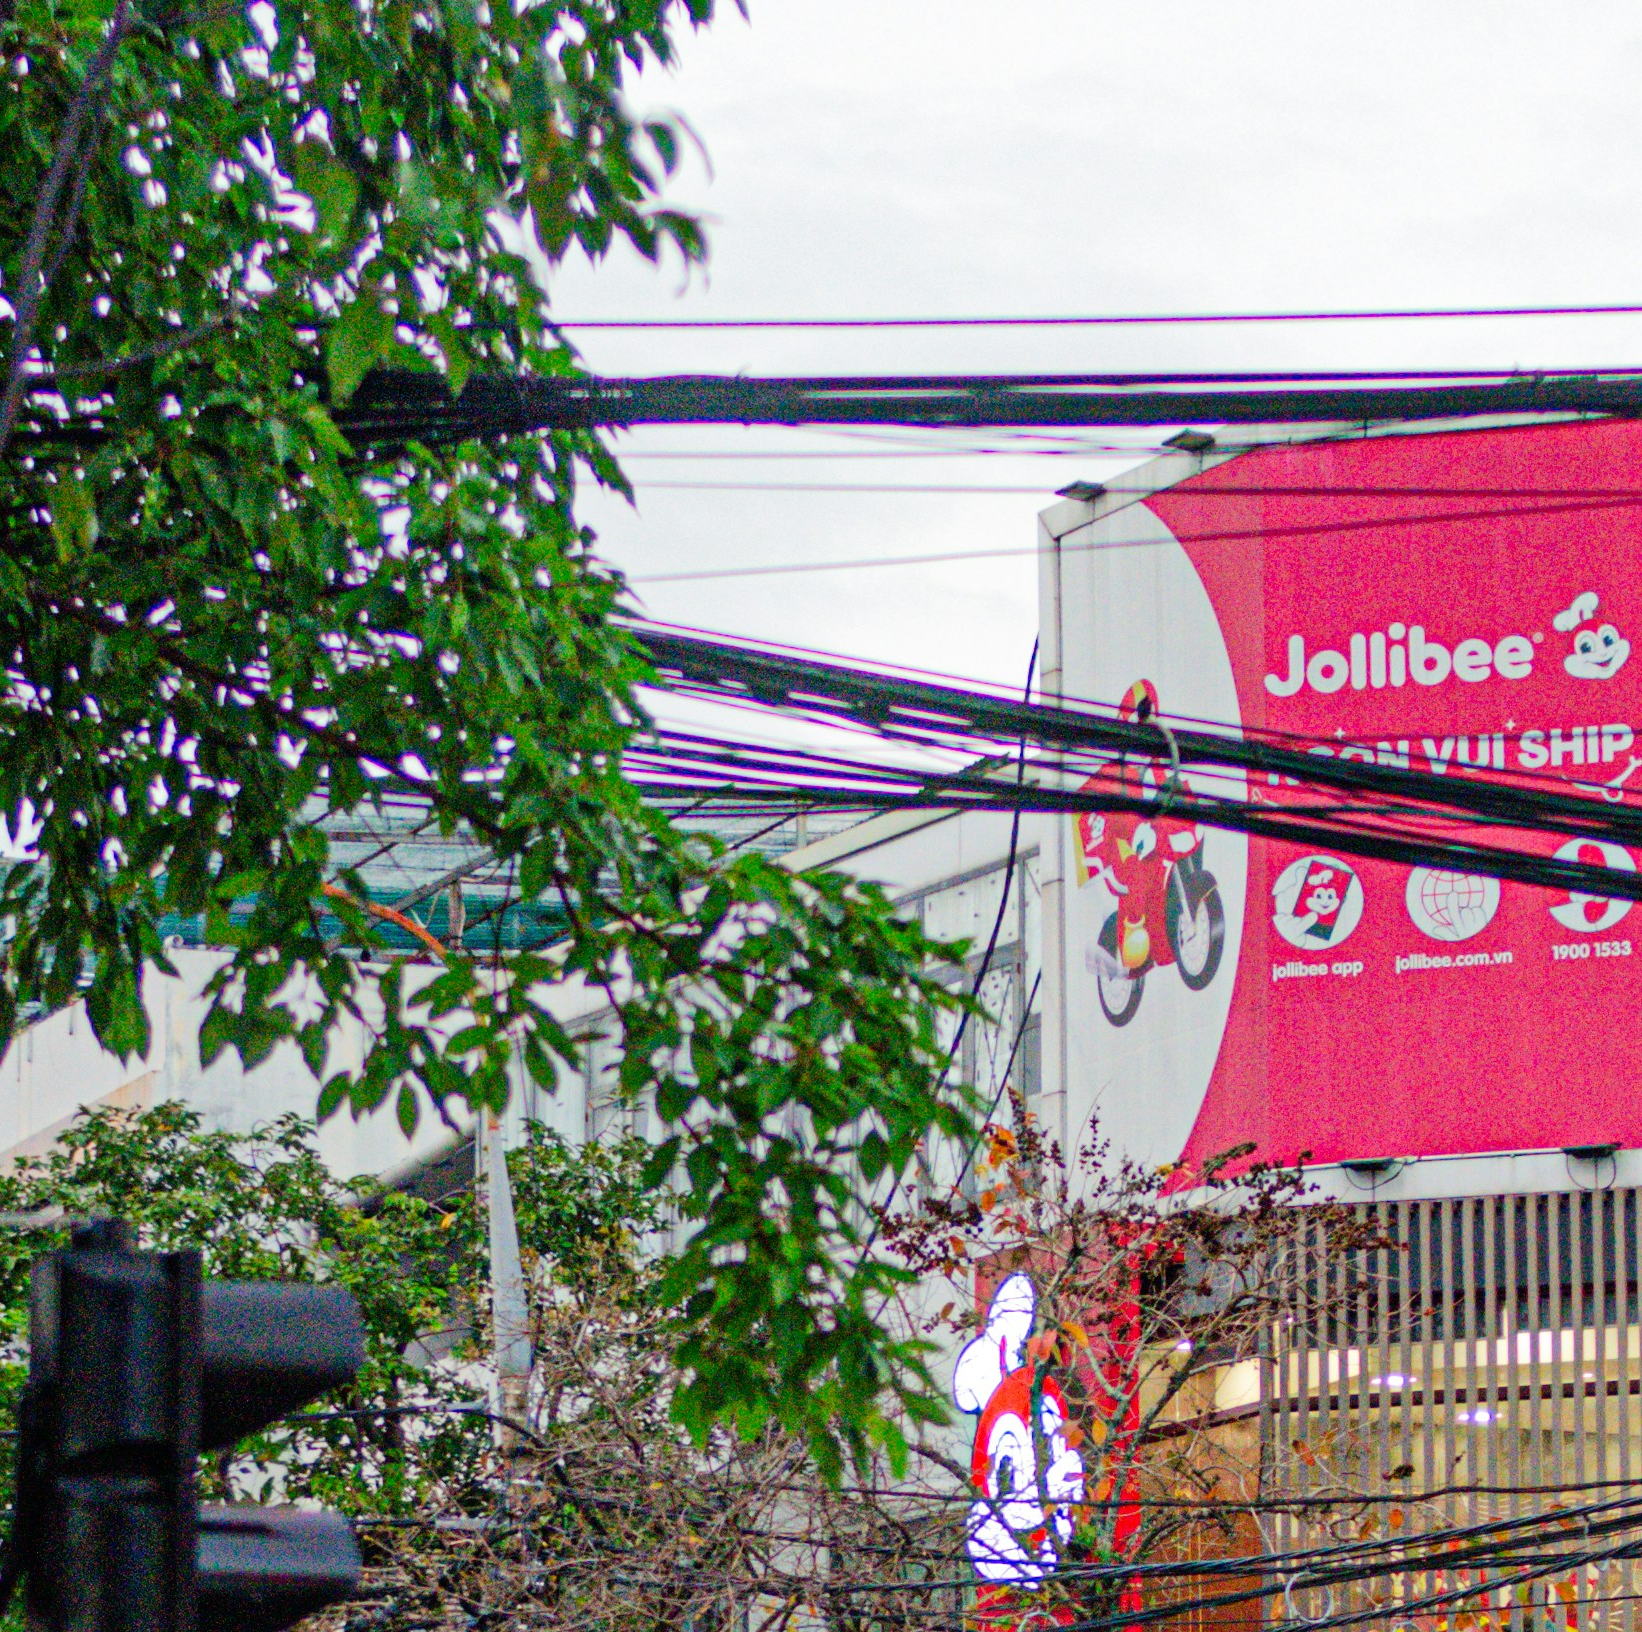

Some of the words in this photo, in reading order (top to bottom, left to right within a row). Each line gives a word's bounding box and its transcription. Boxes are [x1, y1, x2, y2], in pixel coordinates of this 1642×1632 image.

[1264, 622, 1535, 697] Jollibee
[1517, 723, 1634, 768] SHIP
[1395, 949, 1513, 974] jollibee.com.vn
[1552, 944, 1590, 960] 1900
[1594, 940, 1632, 957] 1533
[1272, 961, 1328, 981] jollibee
[1332, 959, 1363, 977] app
